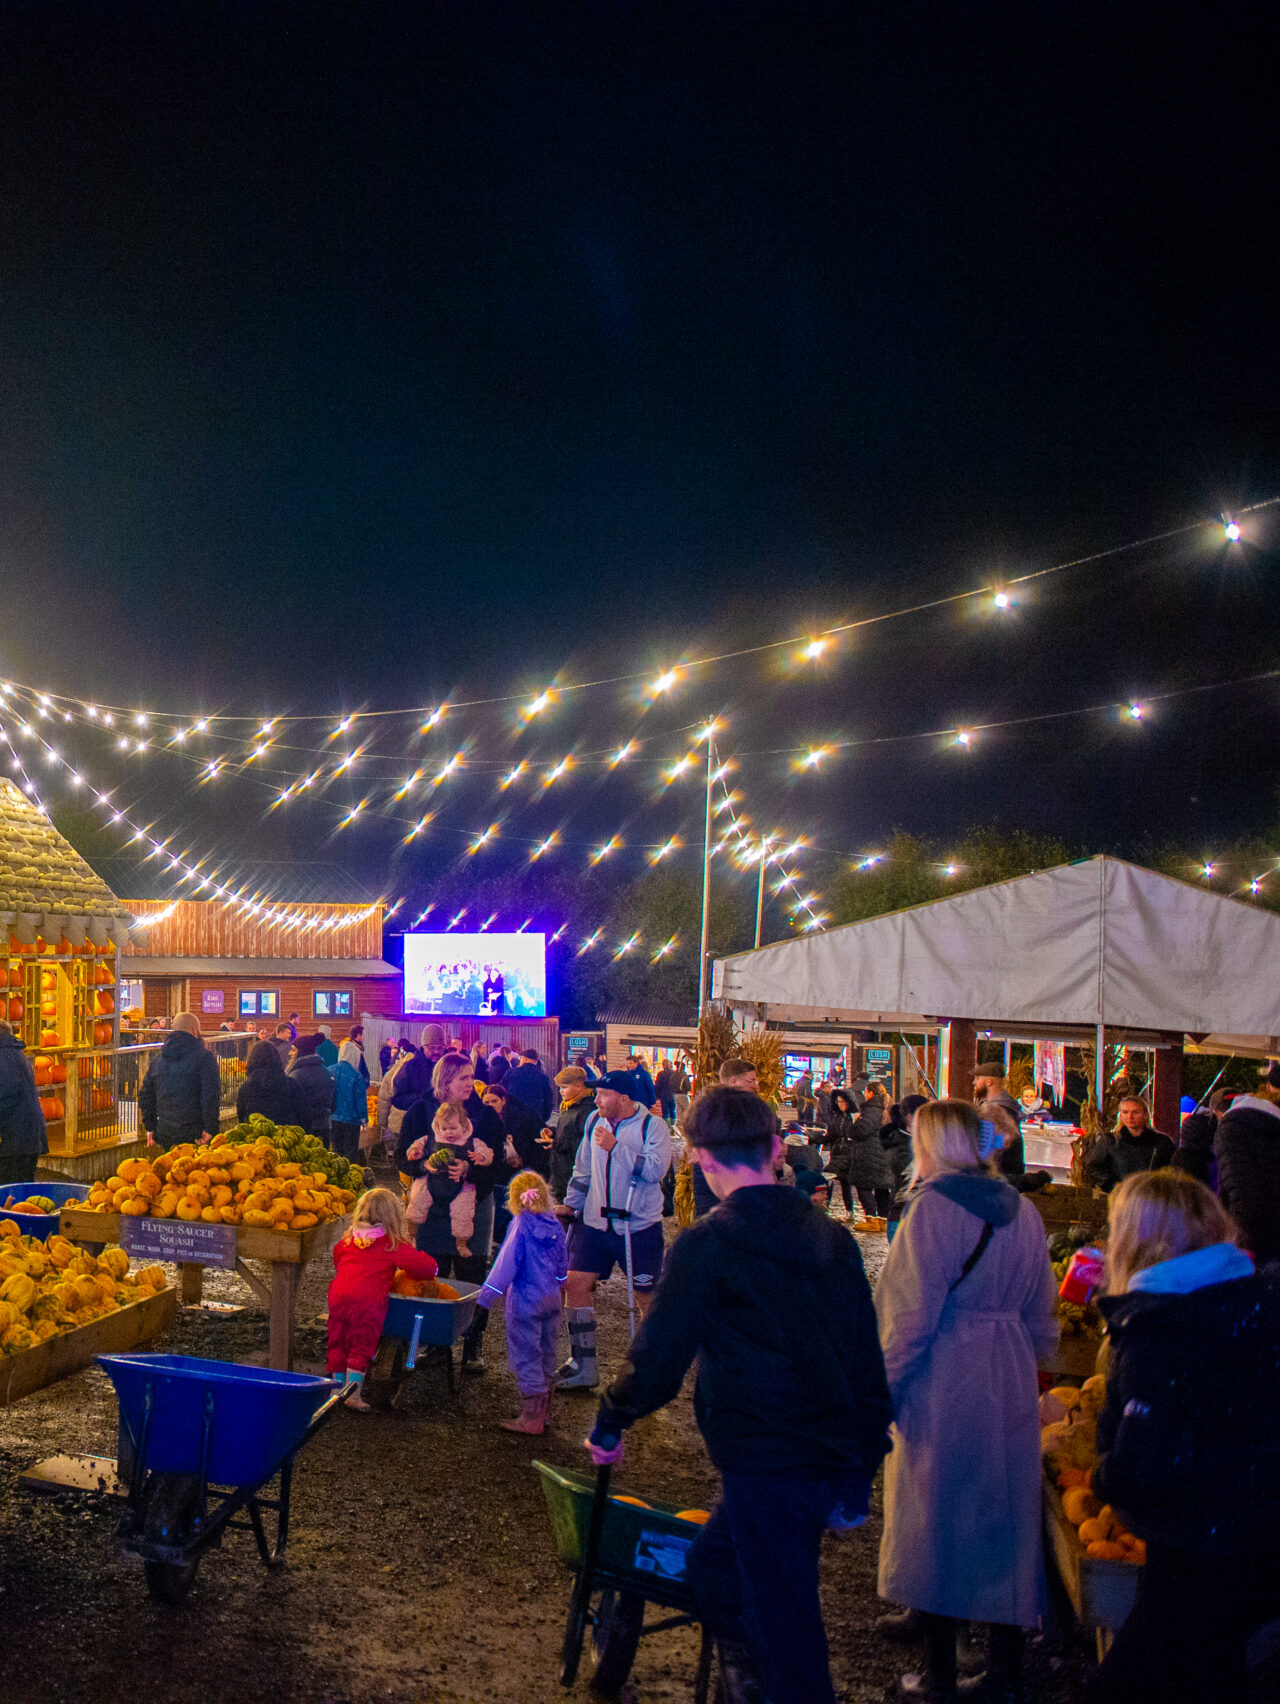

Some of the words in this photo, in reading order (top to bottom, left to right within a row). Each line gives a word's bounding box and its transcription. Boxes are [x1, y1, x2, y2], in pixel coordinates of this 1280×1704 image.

[141, 1221, 175, 1234] FLYING
[177, 1225, 214, 1238] SAUCER
[159, 1234, 194, 1247] SQUASH
